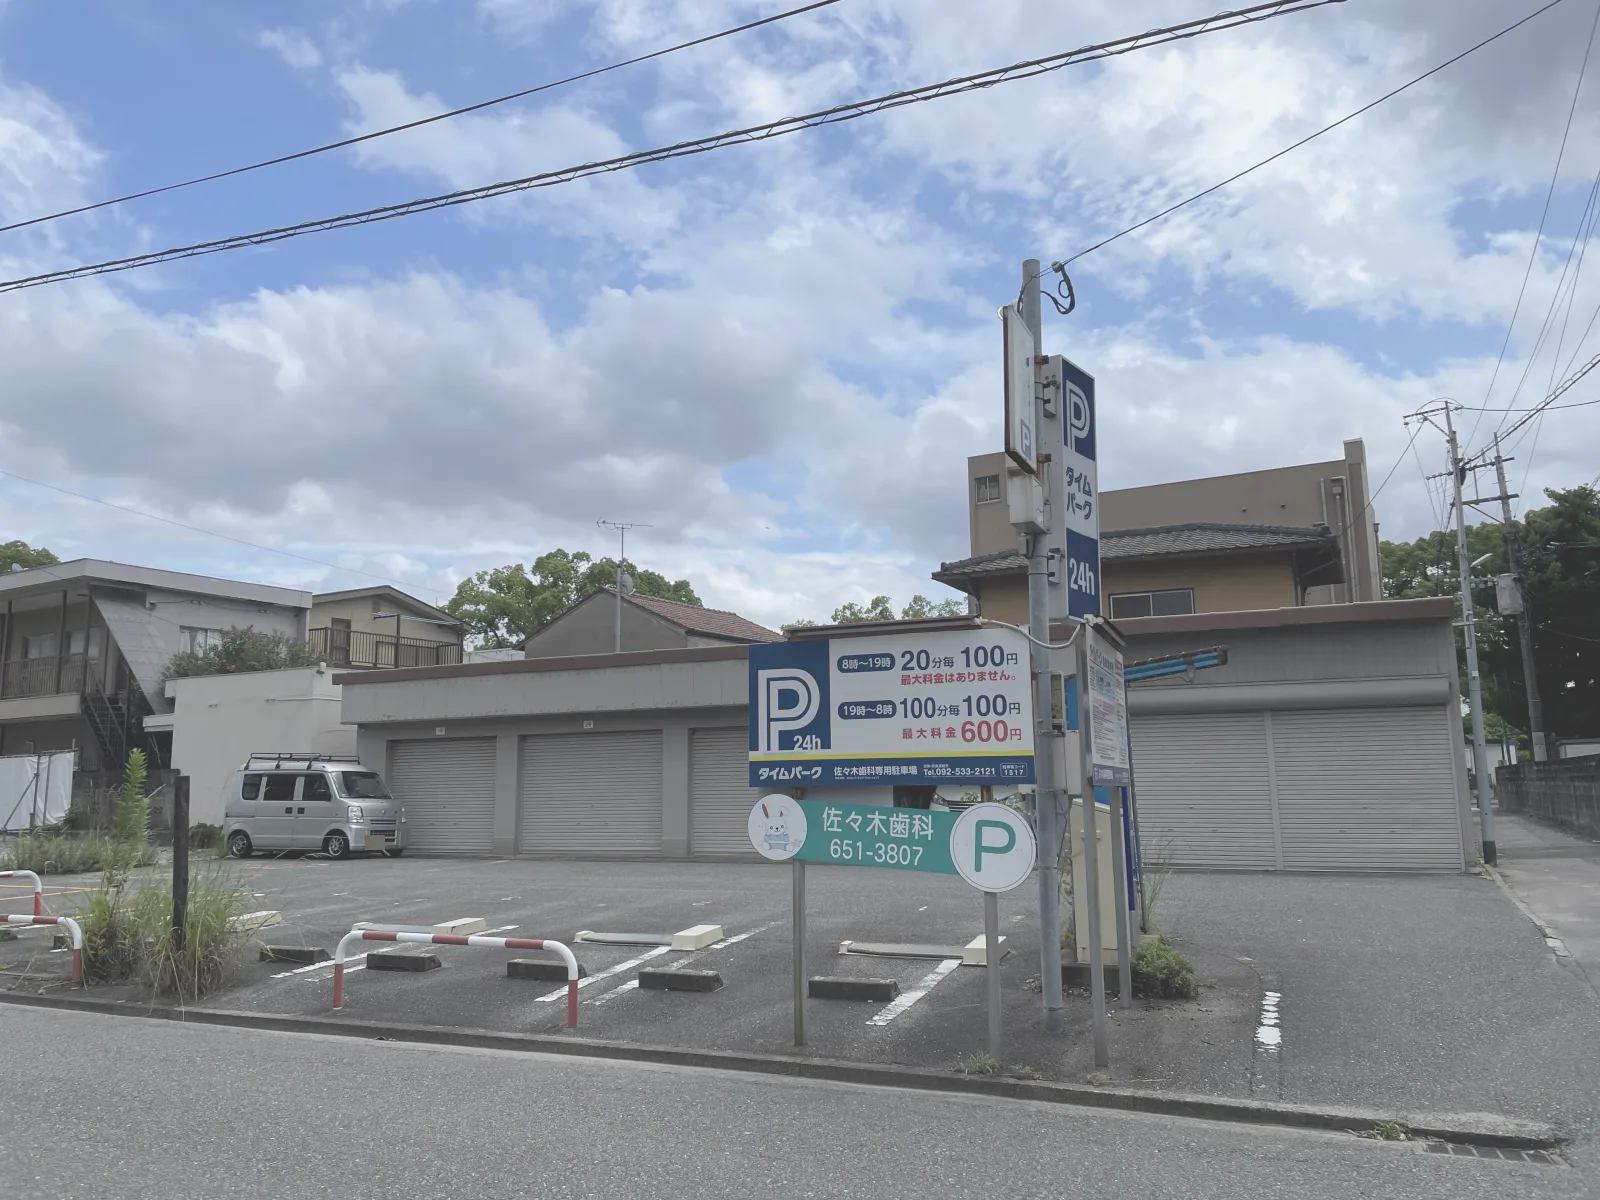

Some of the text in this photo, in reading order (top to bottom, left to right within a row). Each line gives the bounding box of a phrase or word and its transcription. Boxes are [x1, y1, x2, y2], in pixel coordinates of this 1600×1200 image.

[1066, 379, 1091, 452] P
[1065, 466, 1092, 497] タイム
[1066, 491, 1092, 520] パーク
[1069, 557, 1095, 595] 24h
[900, 649, 955, 672] 20分毎
[961, 645, 1018, 668] 100円
[900, 670, 1015, 686] 最大料金はありません。
[758, 668, 820, 751] P
[900, 697, 960, 719] 100分毎
[962, 694, 1021, 716] 100円
[793, 734, 821, 750] 24h
[902, 719, 1022, 743] 最大料金 600円
[758, 766, 822, 780] タイムパーク
[833, 765, 918, 776] 佐々木歯科専用駐車場
[923, 767, 995, 776] Tel.092-533-2121
[822, 806, 934, 841] 佐々木歯科
[829, 838, 924, 866] 651-3807
[974, 819, 1017, 873] P
